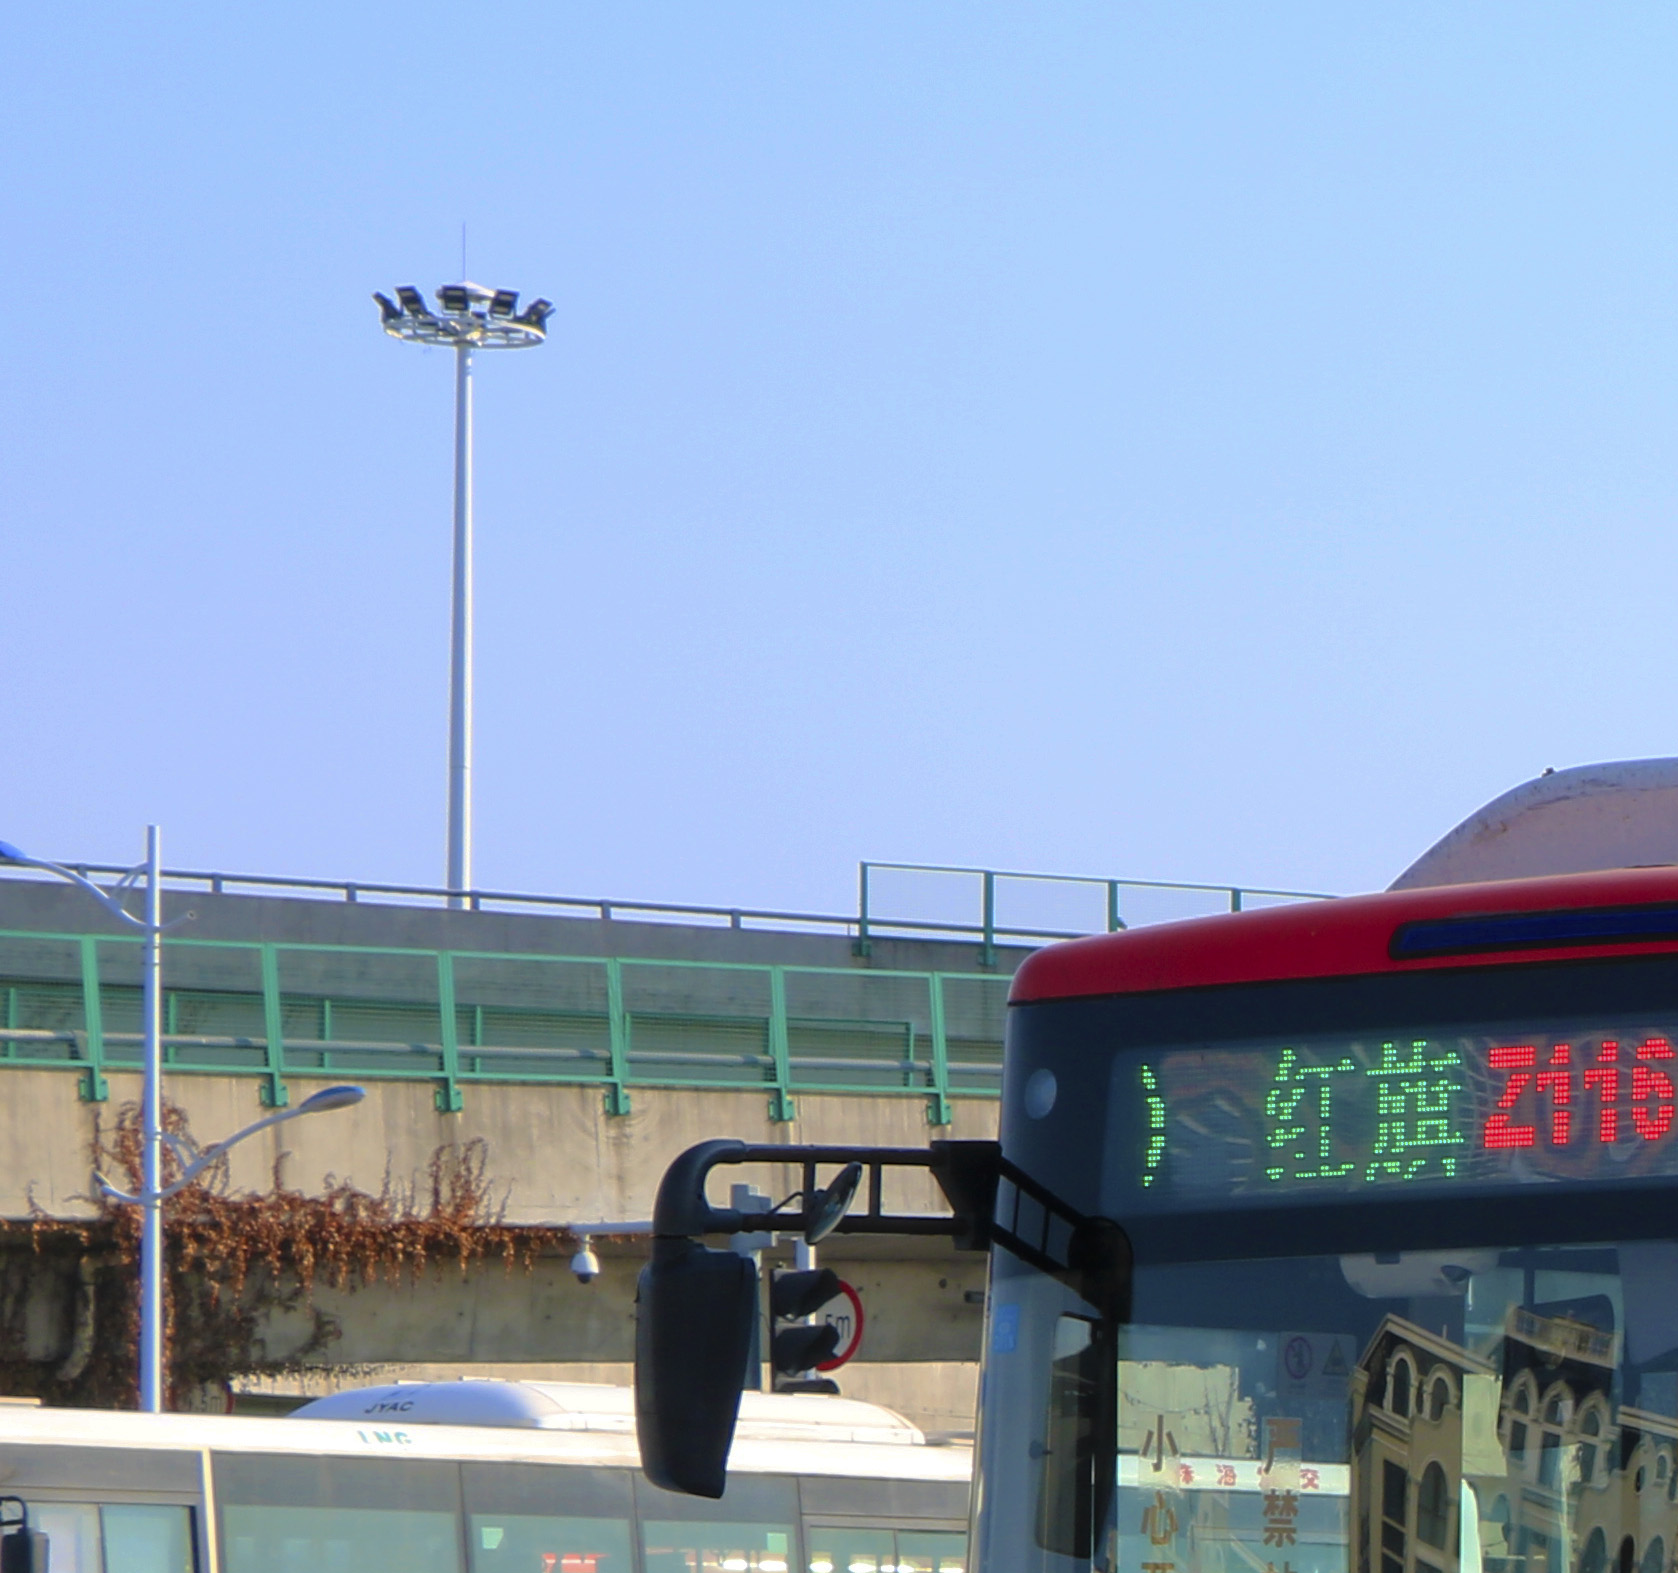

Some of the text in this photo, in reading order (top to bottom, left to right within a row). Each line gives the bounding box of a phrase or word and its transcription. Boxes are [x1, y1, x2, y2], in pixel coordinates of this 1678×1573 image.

[1266, 1039, 1464, 1182] 红旗
[1484, 1038, 1677, 1149] Z116
[364, 1401, 414, 1414] JYAC
